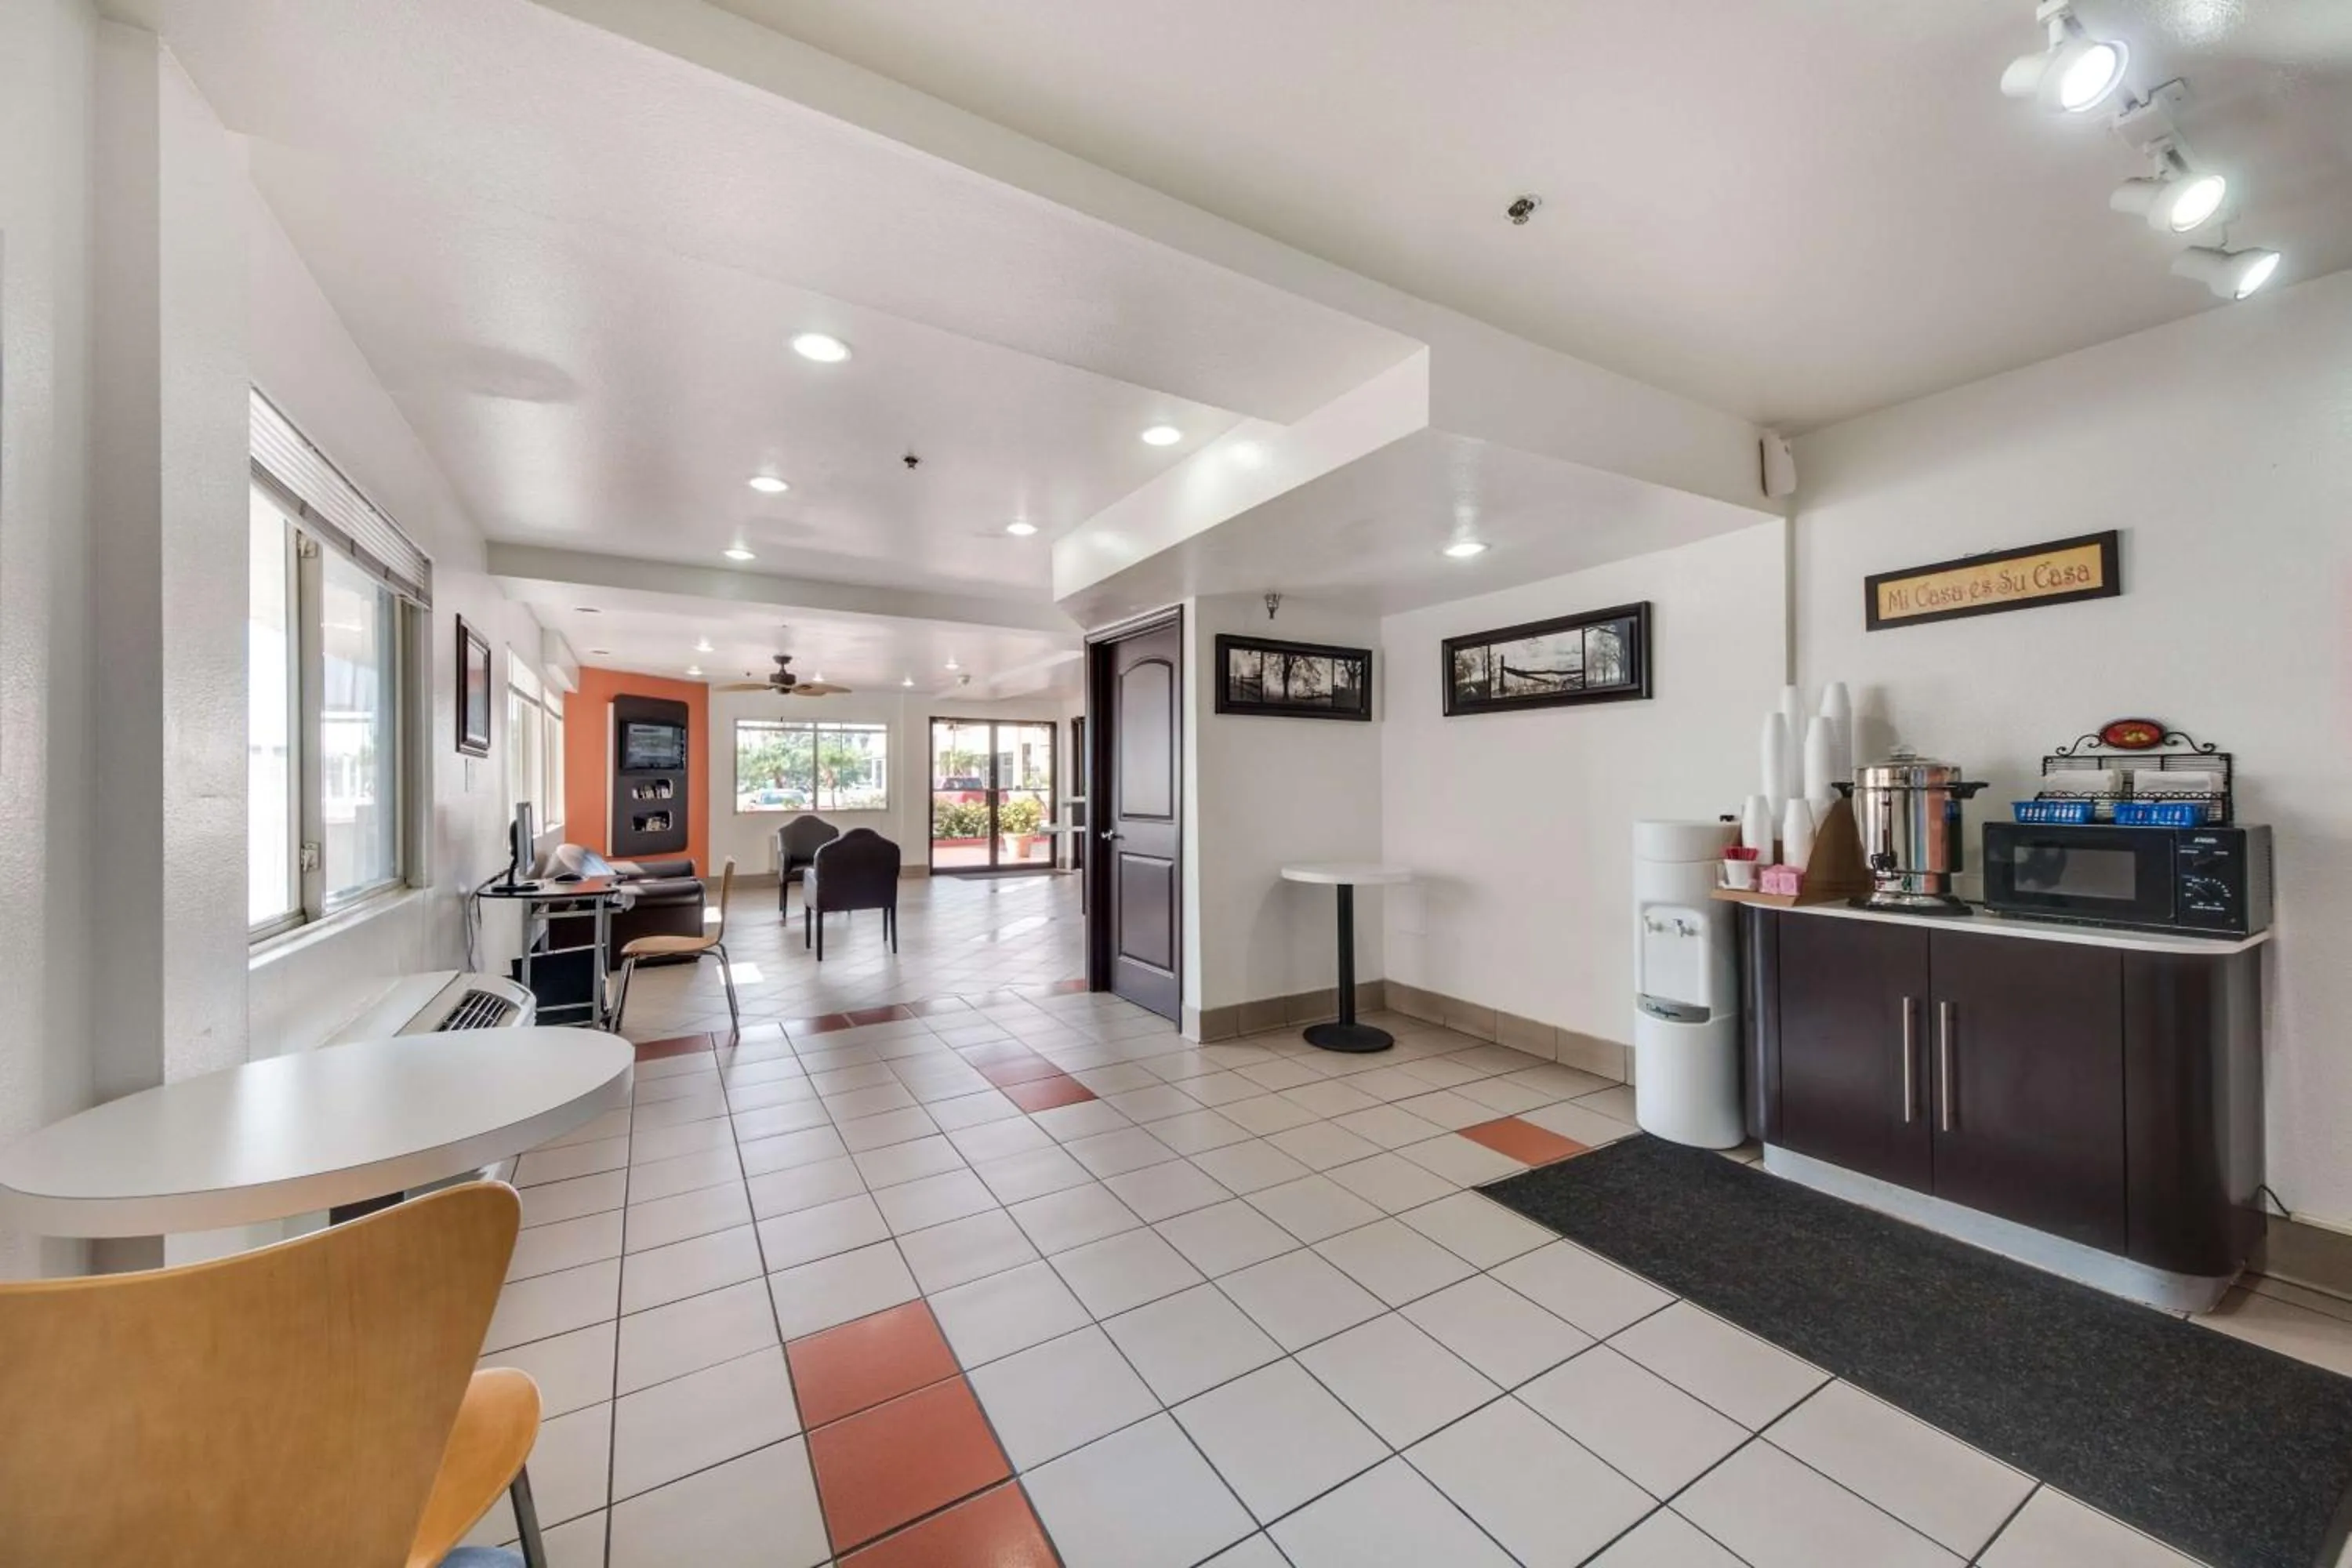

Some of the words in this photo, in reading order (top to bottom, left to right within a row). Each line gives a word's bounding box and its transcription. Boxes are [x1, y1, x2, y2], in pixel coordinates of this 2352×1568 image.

[1888, 589, 1910, 612] Mi
[1915, 582, 1963, 607] Casa
[1969, 579, 1992, 602] es
[1997, 569, 2026, 594] Su
[2033, 561, 2090, 589] Casa
